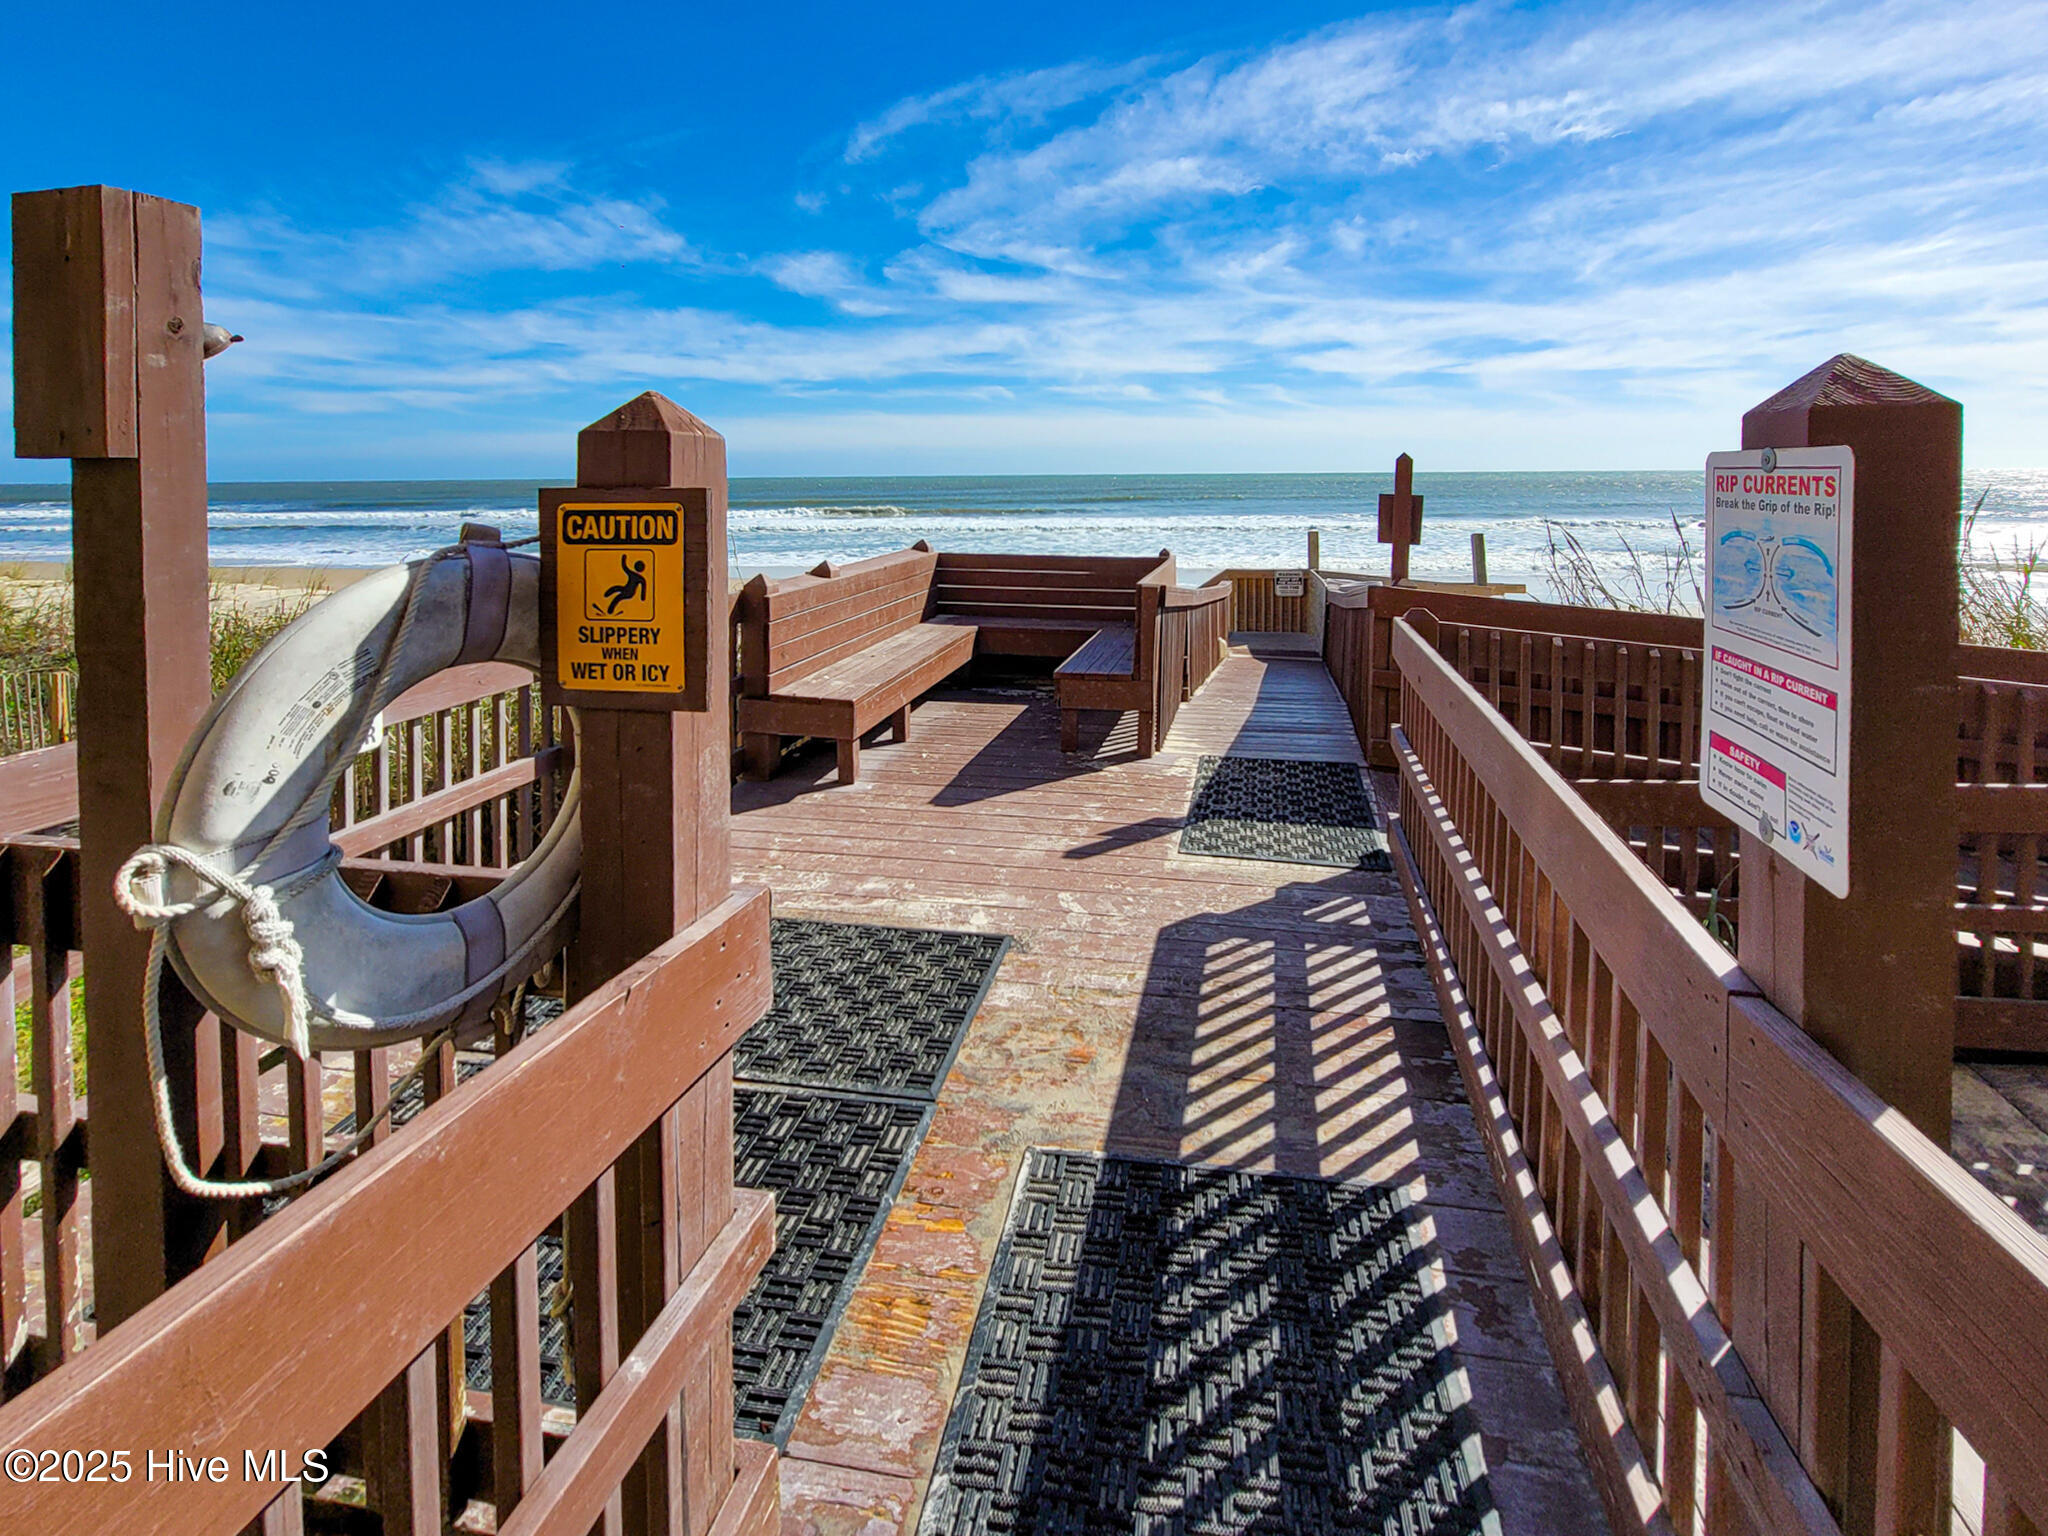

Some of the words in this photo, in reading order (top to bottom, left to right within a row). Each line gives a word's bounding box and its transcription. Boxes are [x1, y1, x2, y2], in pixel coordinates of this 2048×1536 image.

[1716, 475, 1738, 492] RIP
[1743, 475, 1836, 497] CURRENTS
[1715, 497, 1739, 509] Break
[1741, 499, 1756, 511] the
[1758, 500, 1778, 515] Grip
[1780, 501, 1791, 513] of
[1794, 502, 1810, 515] the
[1814, 503, 1836, 519] Rip!
[566, 514, 674, 540] CAUTION
[578, 626, 661, 645] SLIPPERY
[601, 647, 638, 661] WHEN
[571, 662, 607, 680] WET
[612, 663, 636, 682] OR
[642, 664, 670, 682] ICY
[1715, 650, 1722, 661] IF
[1723, 653, 1753, 673] CAUGHT
[1753, 664, 1763, 678] IN
[1763, 669, 1770, 681] A
[1770, 672, 1784, 686] RIP
[1785, 678, 1828, 705] CURRENT
[1729, 745, 1761, 772] SAFETY
